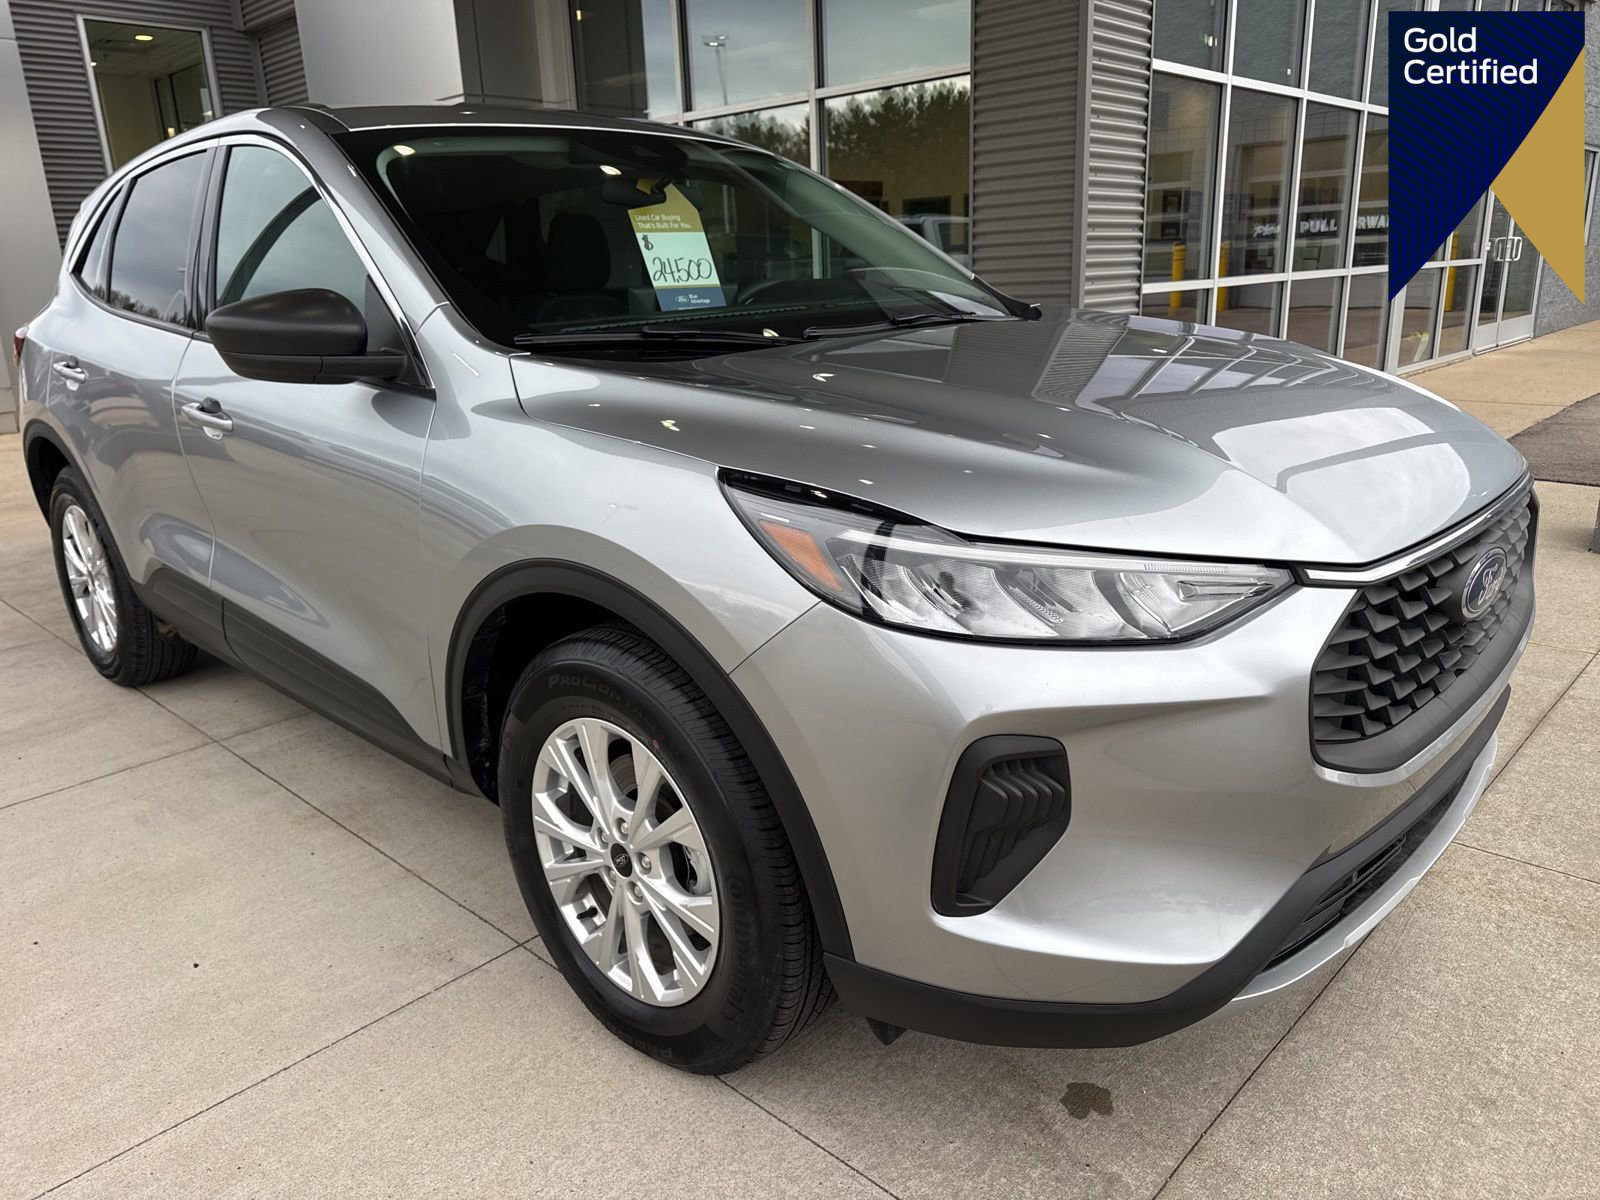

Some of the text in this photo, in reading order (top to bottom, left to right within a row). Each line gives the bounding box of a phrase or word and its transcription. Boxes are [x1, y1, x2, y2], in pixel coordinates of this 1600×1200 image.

[634, 213, 680, 222] Used Car Buying
[670, 221, 679, 229] For
[1300, 218, 1338, 234] PULL
[652, 256, 713, 283] 24,500
